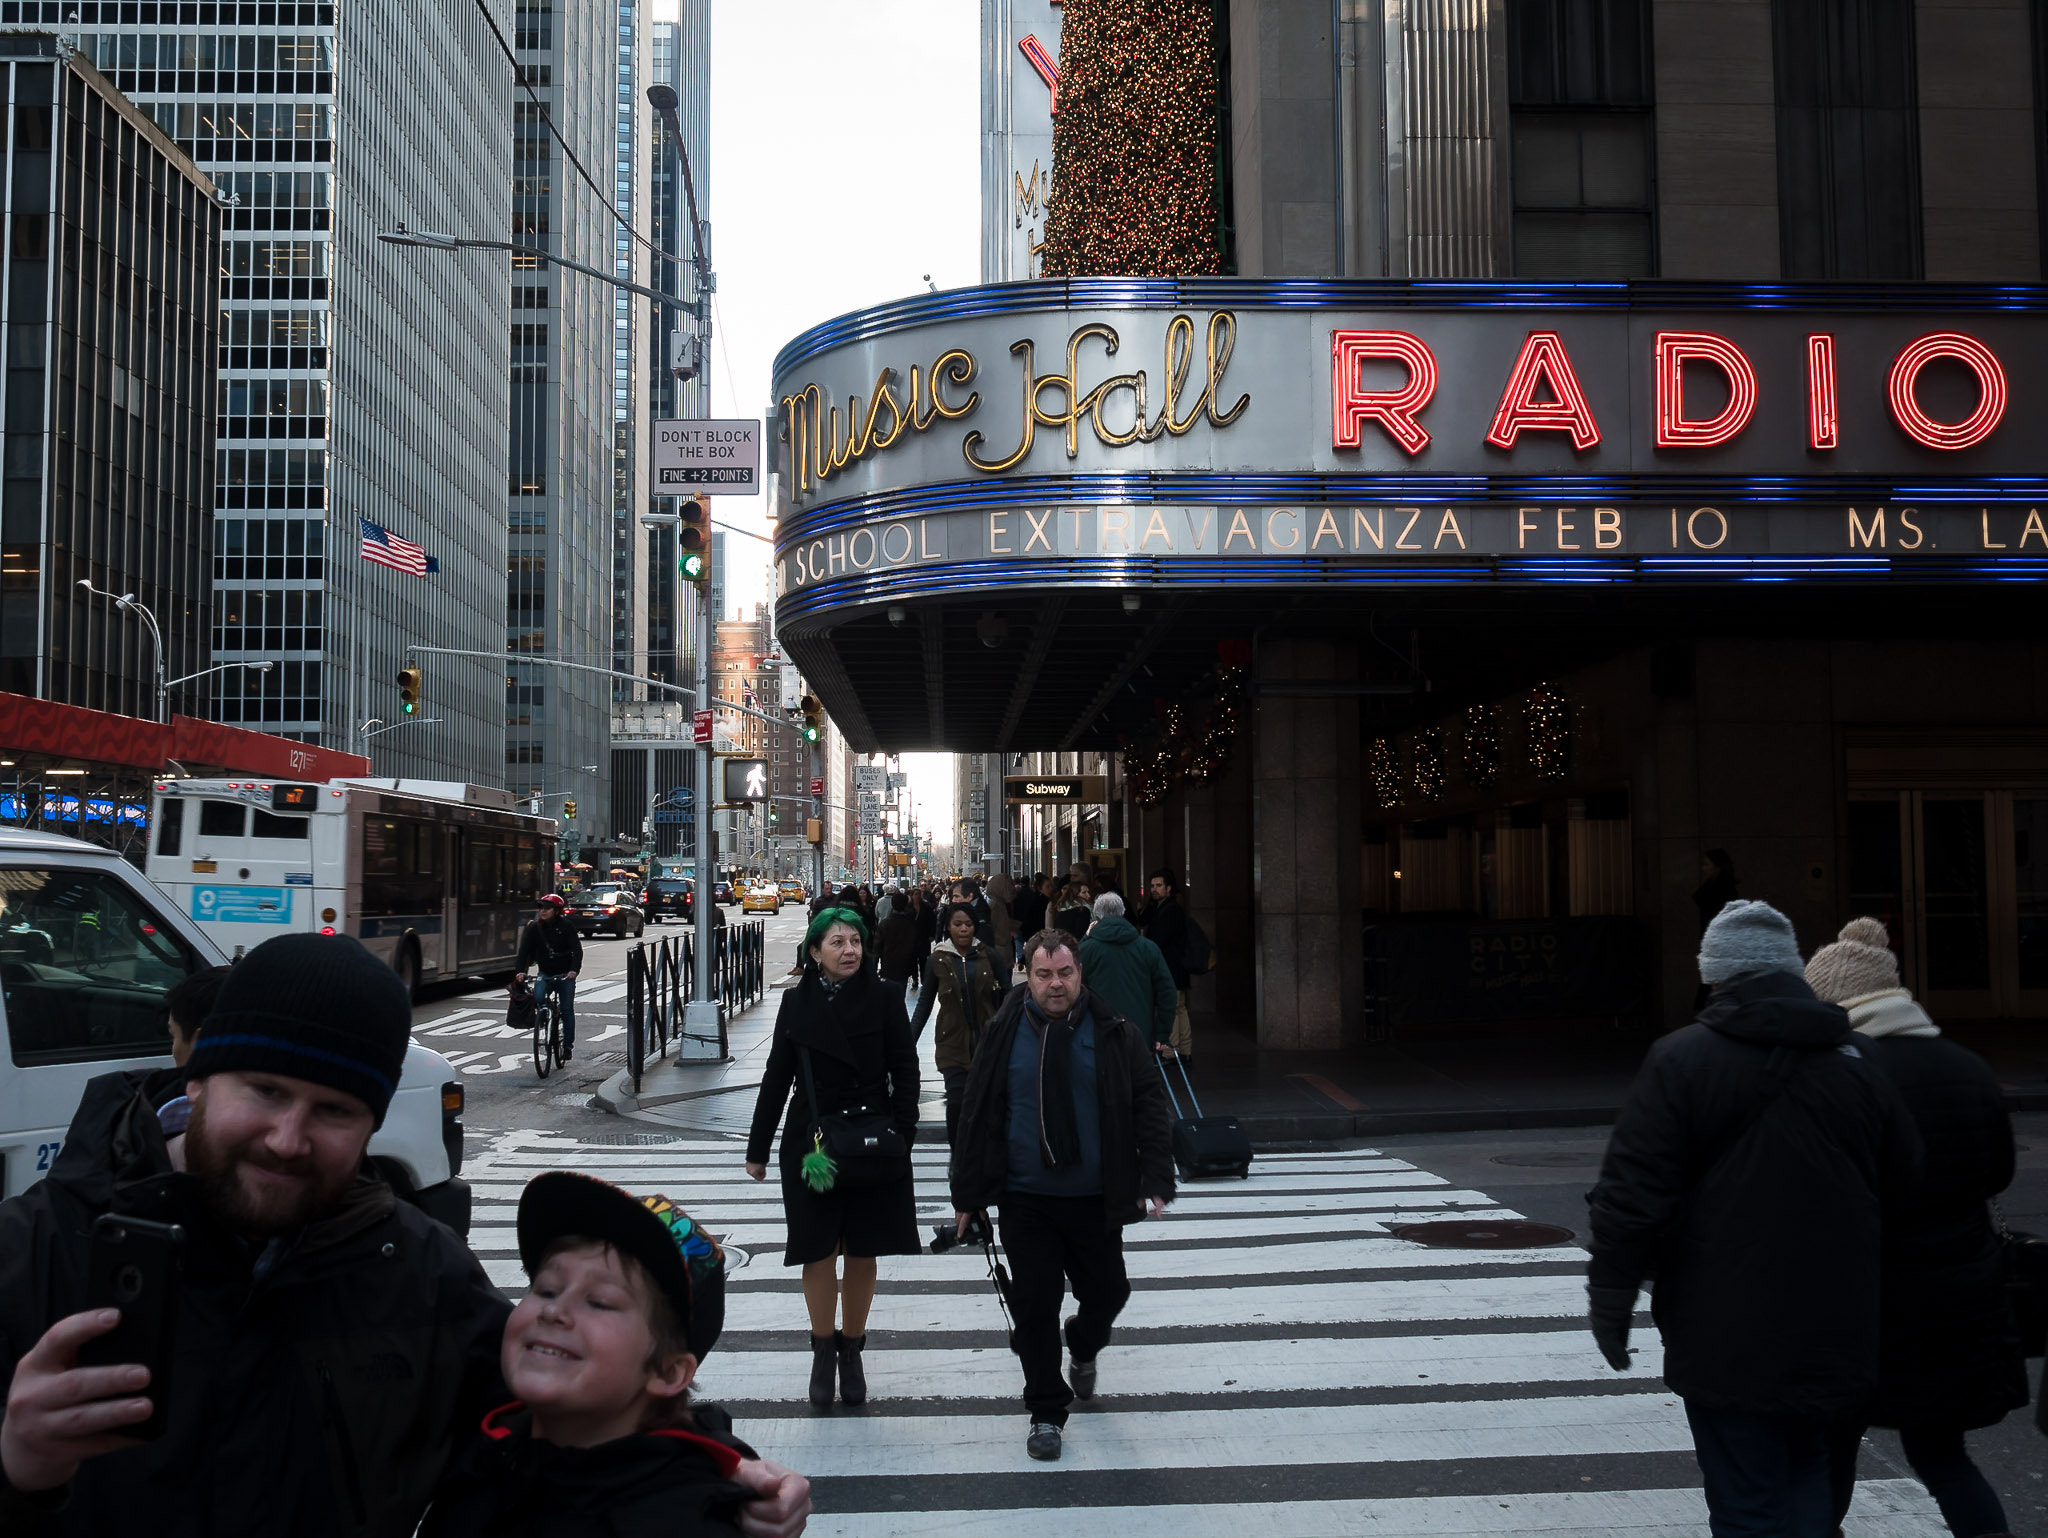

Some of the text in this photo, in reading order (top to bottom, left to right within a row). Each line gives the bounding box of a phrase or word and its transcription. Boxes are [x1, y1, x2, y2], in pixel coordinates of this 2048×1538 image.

[1332, 330, 2008, 455] RADIO
[778, 308, 1250, 497] Music Hall
[661, 431, 752, 442] DON'T BLOCK
[678, 446, 735, 458] THE BOX
[663, 470, 749, 481] FINE +2 POINTS
[795, 519, 941, 586] SCHOOL
[990, 507, 1467, 553] EXTRAVAGANZA
[1518, 507, 1623, 550] FEB
[1849, 507, 1937, 549] MS.
[290, 749, 306, 772] 1271
[1026, 783, 1070, 796] Subway
[656, 808, 696, 823] Hilto
